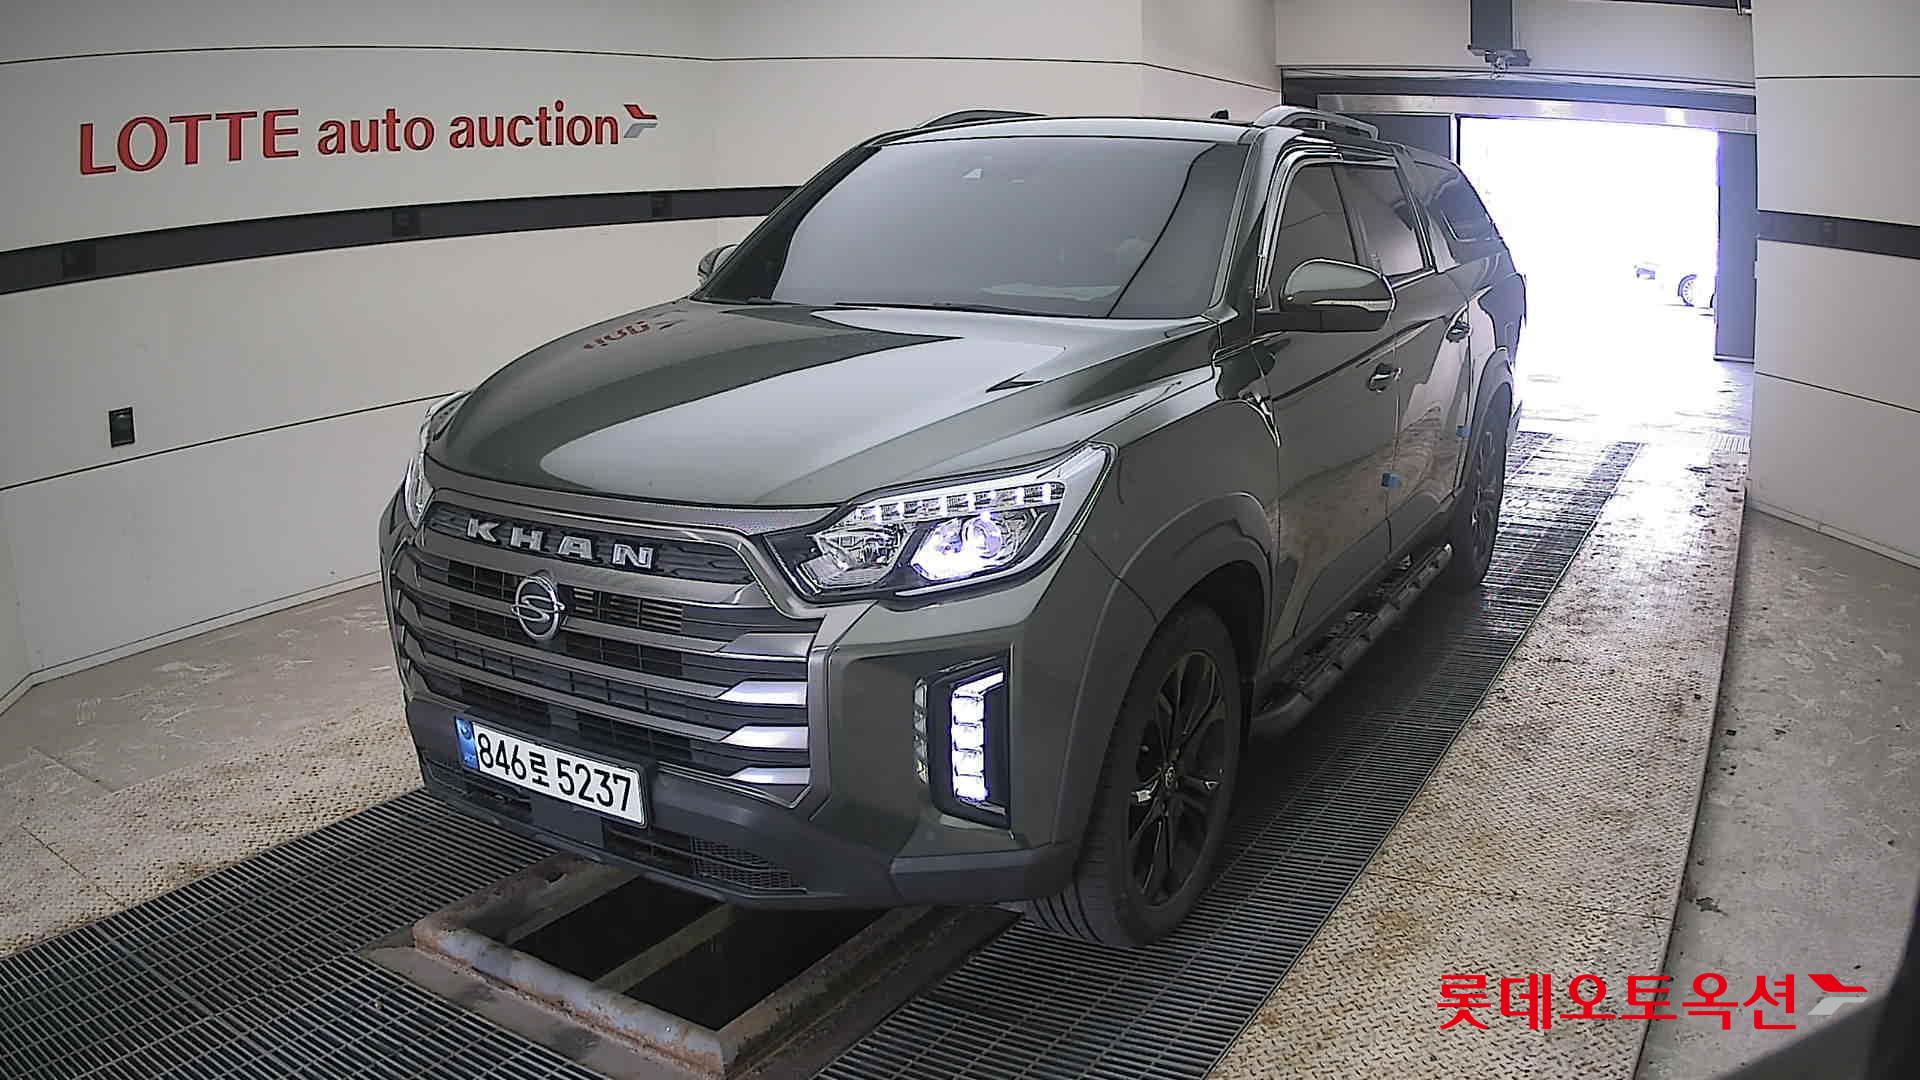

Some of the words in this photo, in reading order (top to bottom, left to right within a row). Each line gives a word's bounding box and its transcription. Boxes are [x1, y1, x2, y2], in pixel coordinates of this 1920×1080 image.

[80, 108, 300, 175] LOTTE
[317, 107, 436, 156] auto
[449, 100, 621, 149] auction
[466, 517, 655, 570] KHAN
[477, 733, 550, 788] 846로
[556, 757, 632, 812] 5237
